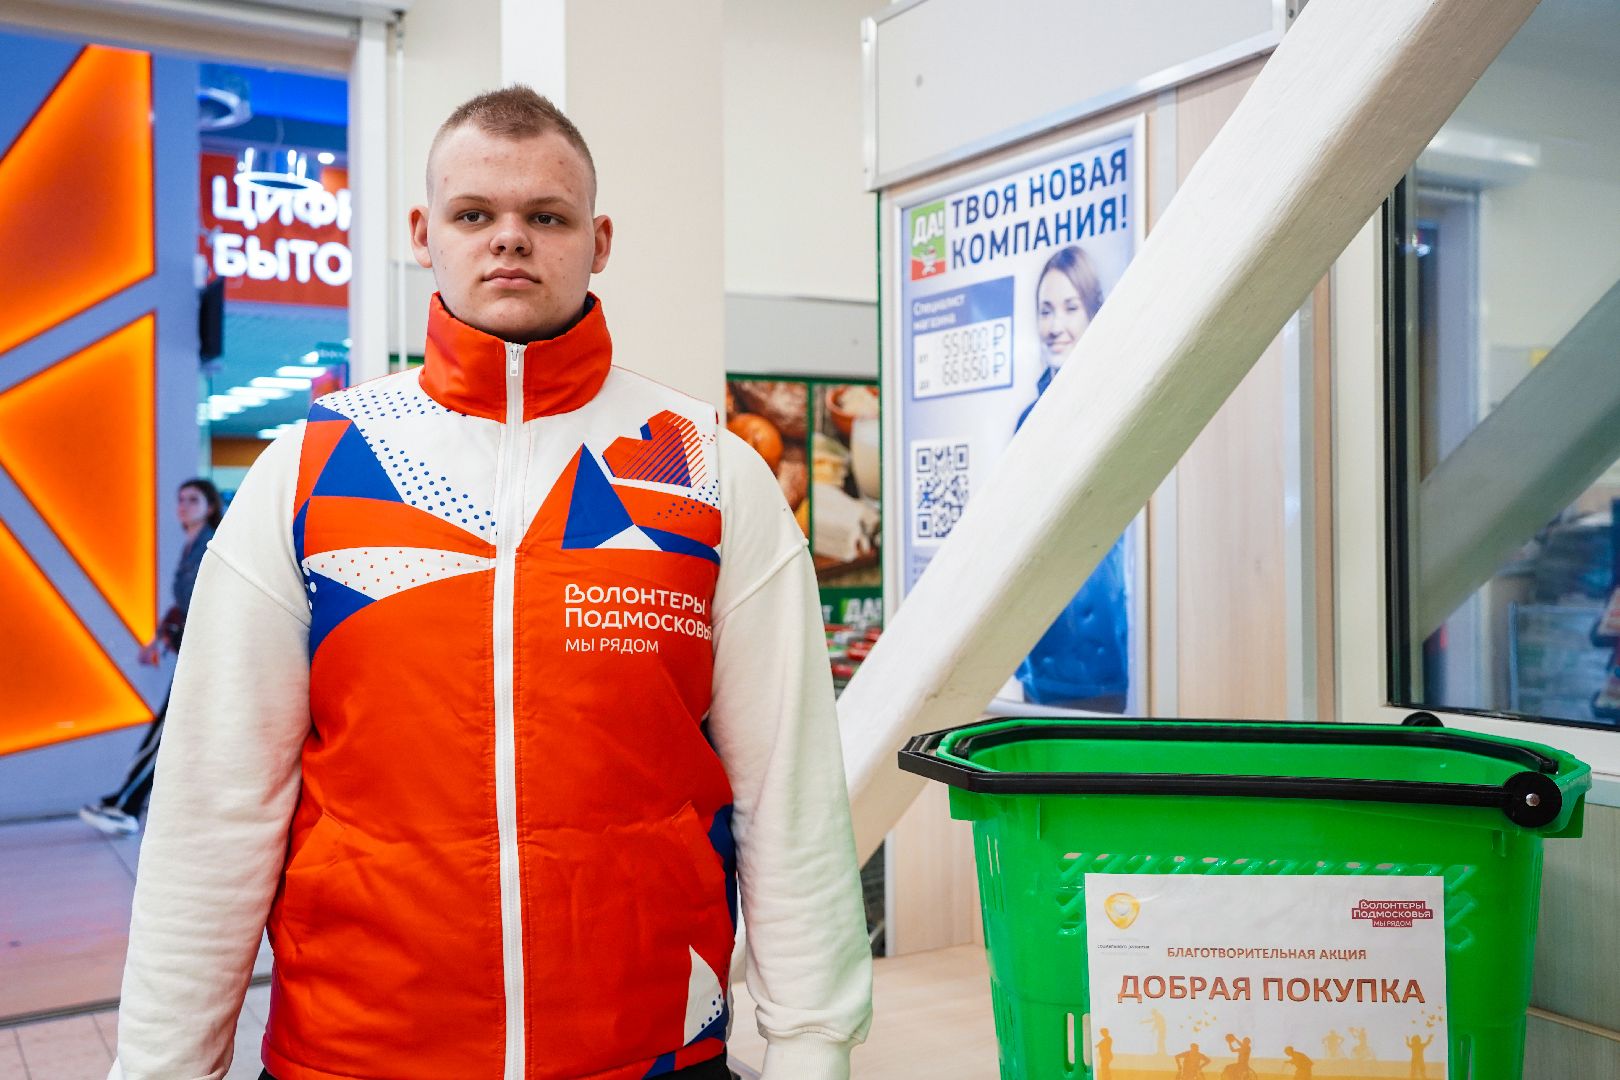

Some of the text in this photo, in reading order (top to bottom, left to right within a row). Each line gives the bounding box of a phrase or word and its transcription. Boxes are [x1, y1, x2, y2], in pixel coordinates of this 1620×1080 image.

[951, 146, 1127, 228] ТВОЯ НОВАЯ
[912, 209, 944, 248] ДА!
[952, 193, 1128, 270] КОМПАНИЯ!
[213, 232, 352, 286] БЫТО
[564, 583, 706, 615] ВОЛОНТЕРЫ
[565, 637, 659, 654] МЫ РЯДОМ
[1352, 909, 1432, 919] ПОДМОСКОВЬЯ
[1360, 900, 1425, 910] ВОЛОНТЕРЫ
[1166, 946, 1367, 961] БЛАГОТВОРИТЕЛЬНАЯ АКЦИЯ
[1117, 974, 1427, 1004] ДОБРАЯ ПОКУПКА
